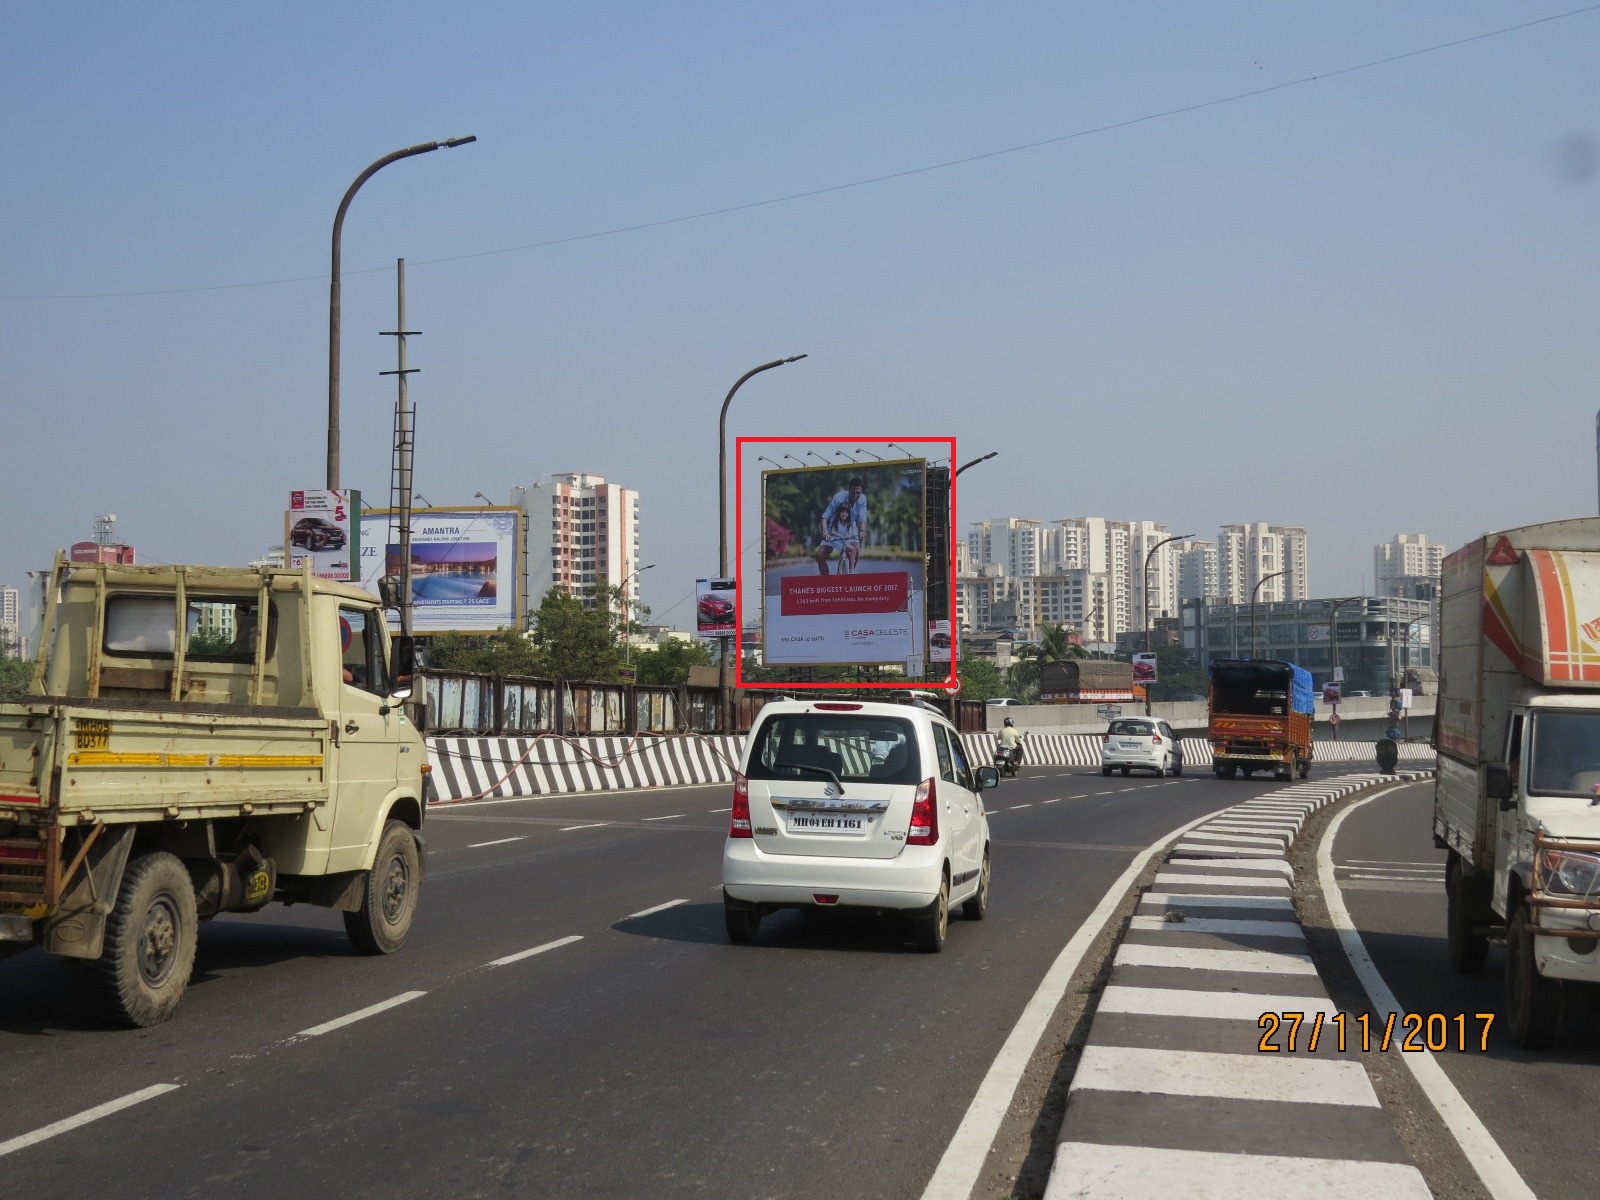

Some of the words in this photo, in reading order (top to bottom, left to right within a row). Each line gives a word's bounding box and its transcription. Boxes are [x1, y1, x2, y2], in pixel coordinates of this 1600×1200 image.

[422, 527, 460, 535] AMANTRA
[816, 586, 842, 594] BIGGEST
[844, 585, 872, 593] LAUNCH
